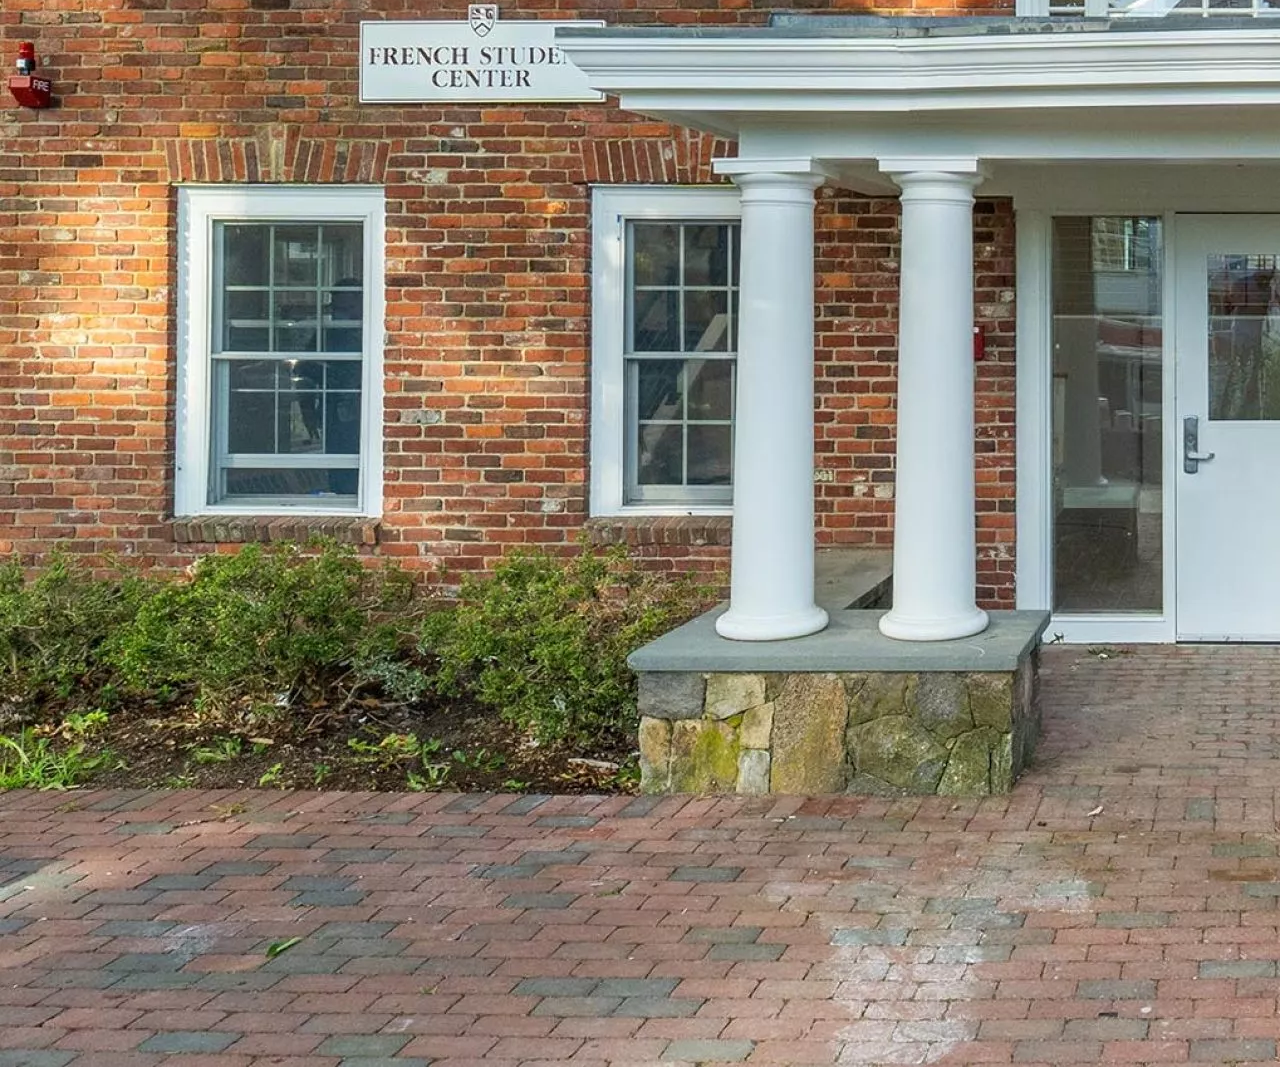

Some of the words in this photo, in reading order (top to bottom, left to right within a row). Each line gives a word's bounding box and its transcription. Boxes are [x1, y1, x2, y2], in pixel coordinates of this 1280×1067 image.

[369, 46, 469, 66] FRENCH
[33, 79, 50, 92] FIRE
[431, 69, 531, 88] CENTER
